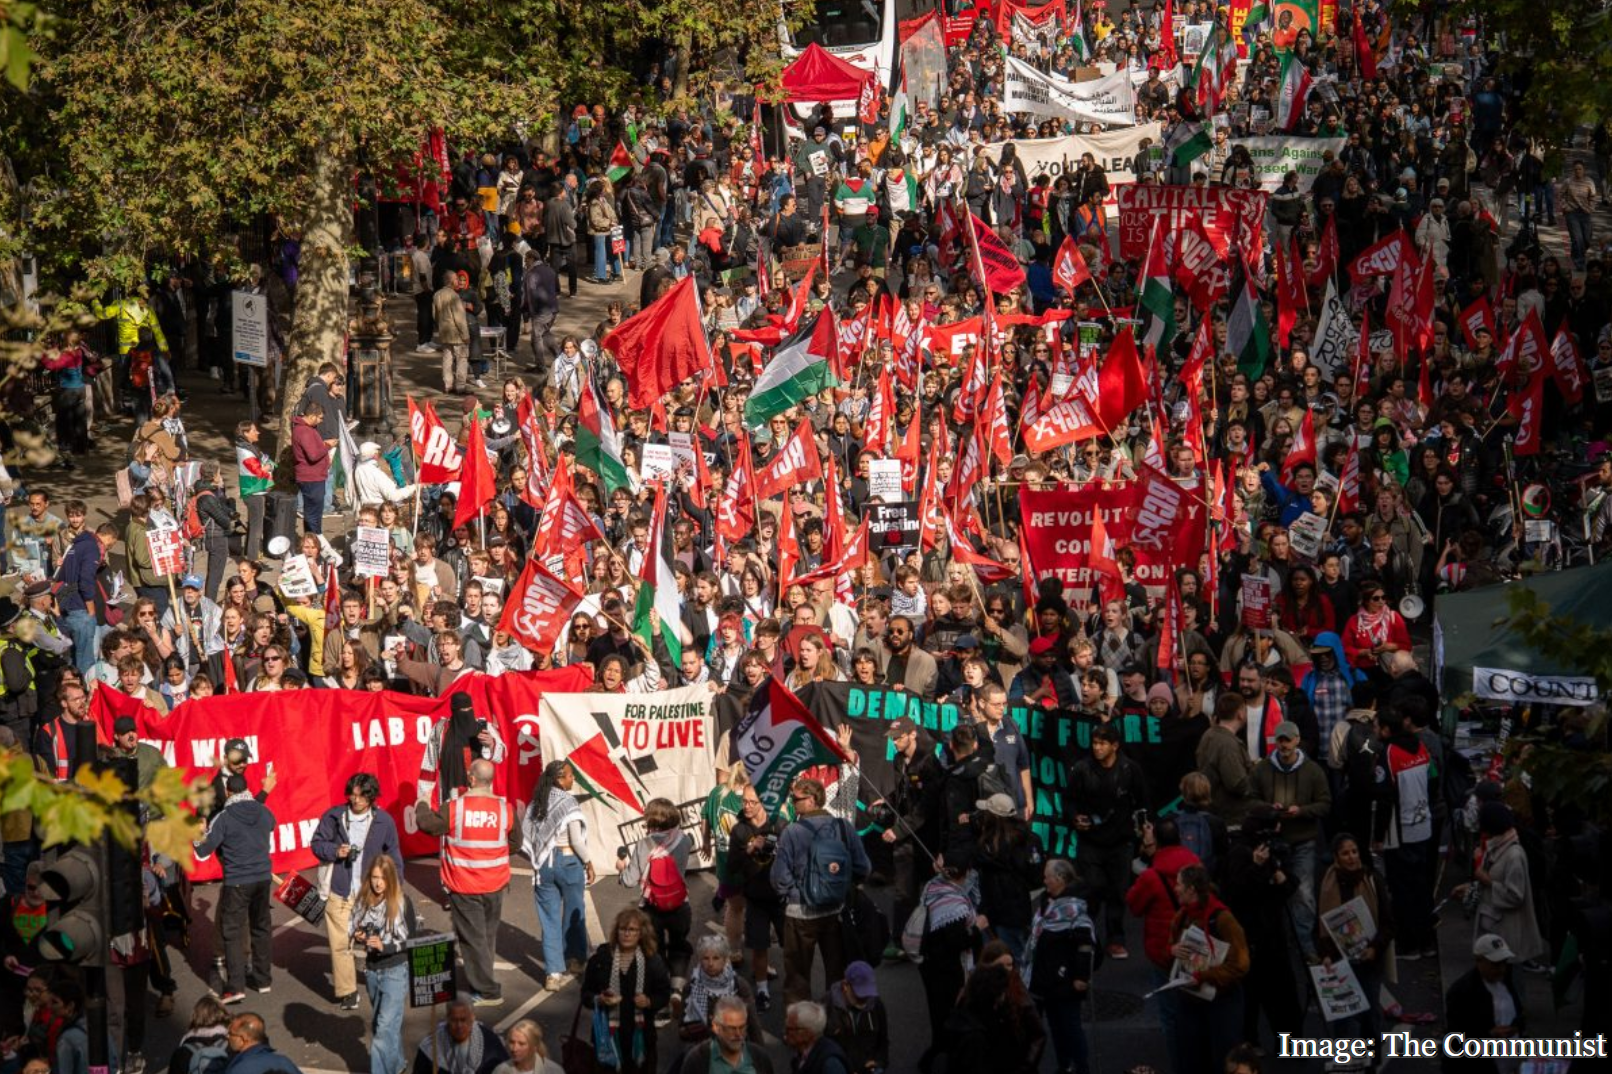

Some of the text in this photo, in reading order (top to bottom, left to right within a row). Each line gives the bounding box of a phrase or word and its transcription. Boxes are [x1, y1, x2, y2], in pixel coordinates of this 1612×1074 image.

[1250, 146, 1323, 160] ans Agains
[1256, 163, 1289, 175] osed
[1126, 227, 1146, 243] IS
[423, 425, 463, 471] RC
[877, 506, 907, 519] Free
[868, 518, 920, 534] Palestin
[625, 702, 705, 720] FOR PALESTINE
[847, 688, 1162, 748] DEMAND HE FURE
[352, 715, 433, 751] LABO
[621, 719, 649, 750] TO
[656, 719, 704, 750] LIVE
[465, 810, 489, 828] RCP
